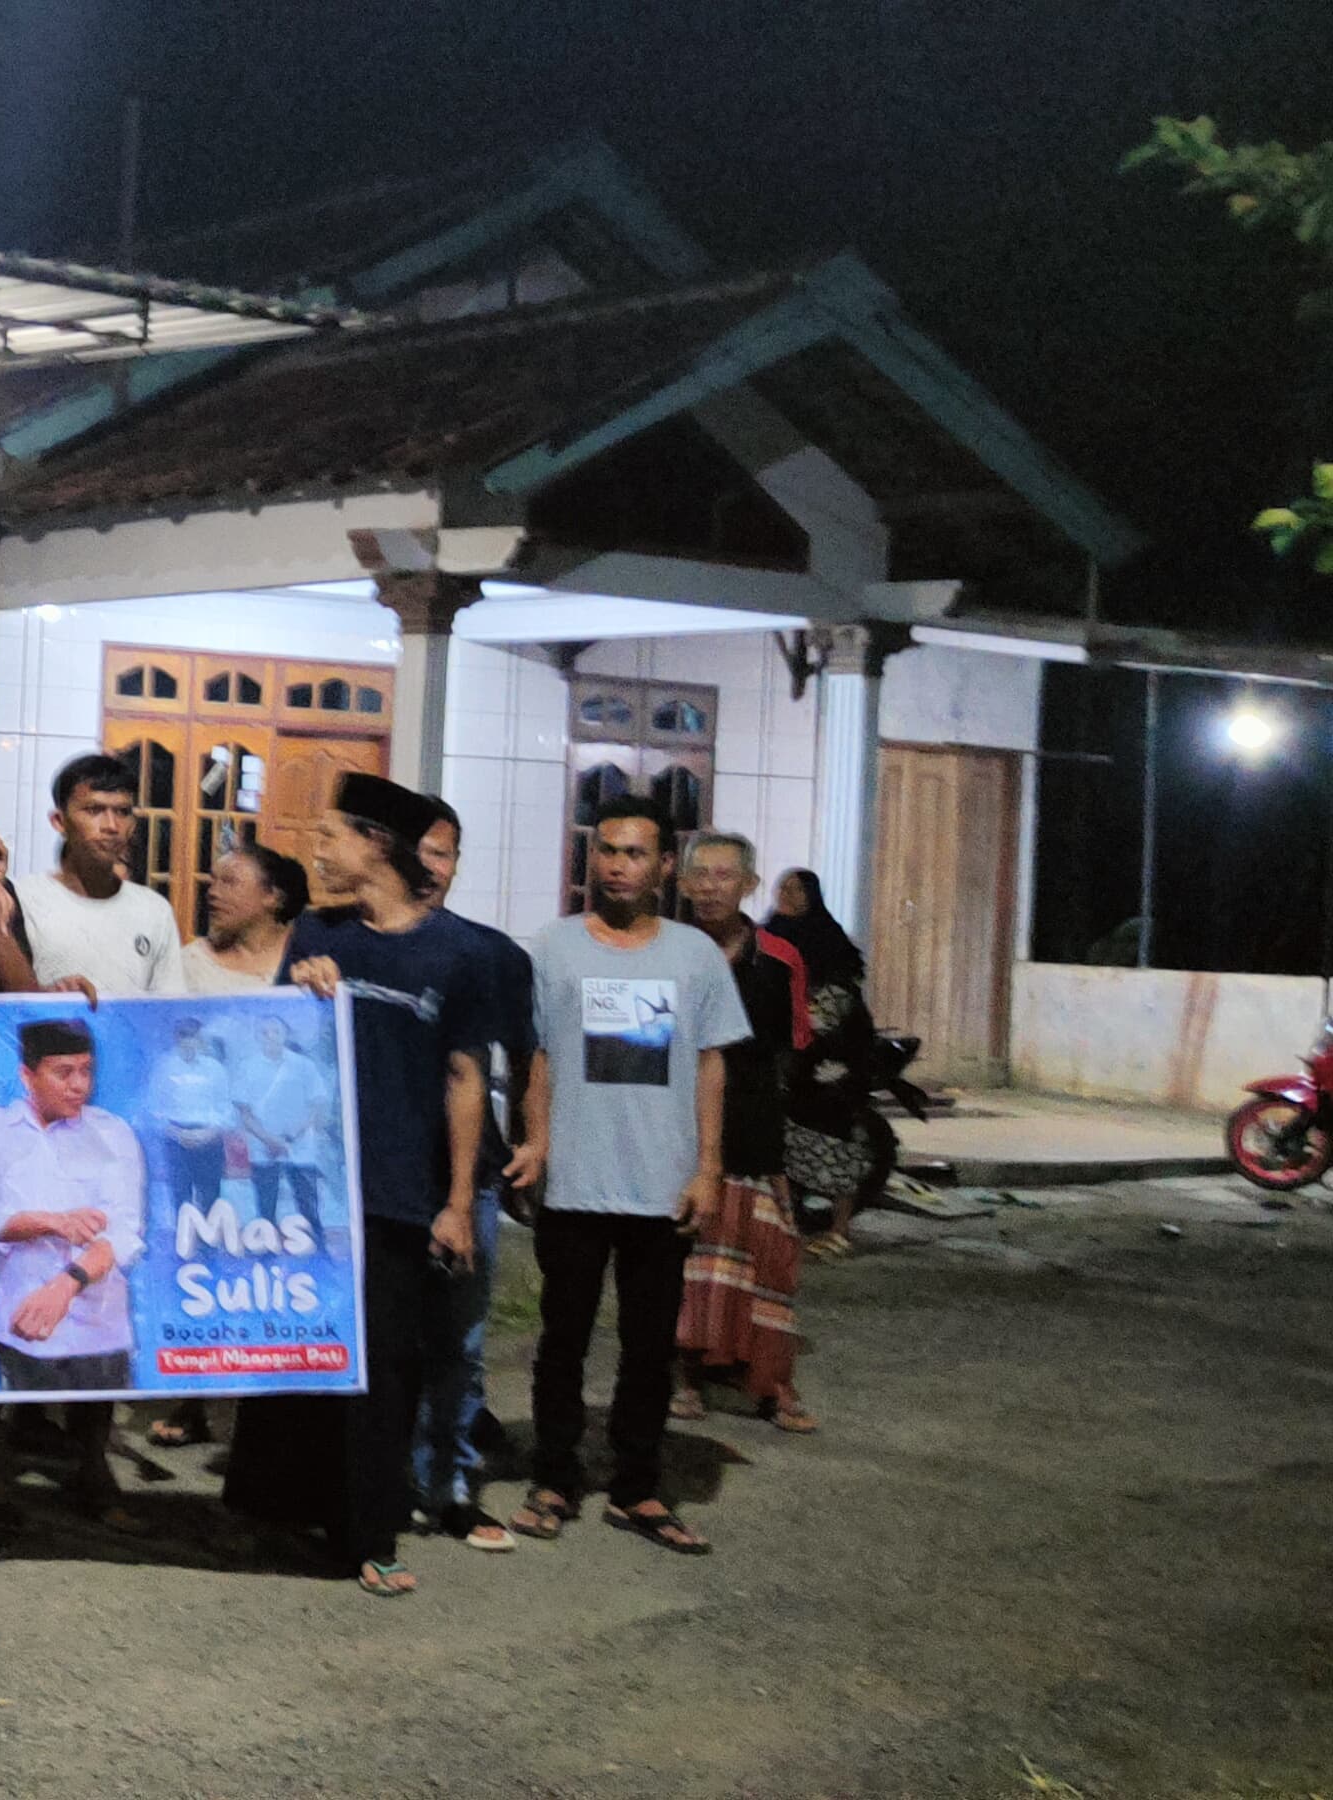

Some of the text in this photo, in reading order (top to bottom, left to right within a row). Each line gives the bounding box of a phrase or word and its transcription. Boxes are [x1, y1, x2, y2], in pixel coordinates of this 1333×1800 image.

[176, 1198, 318, 1260] Mas
[176, 1262, 319, 1318] Sulis
[163, 1320, 339, 1341] Bocahe Bapak
[161, 1347, 344, 1371] Tampil Mbangun Pati
